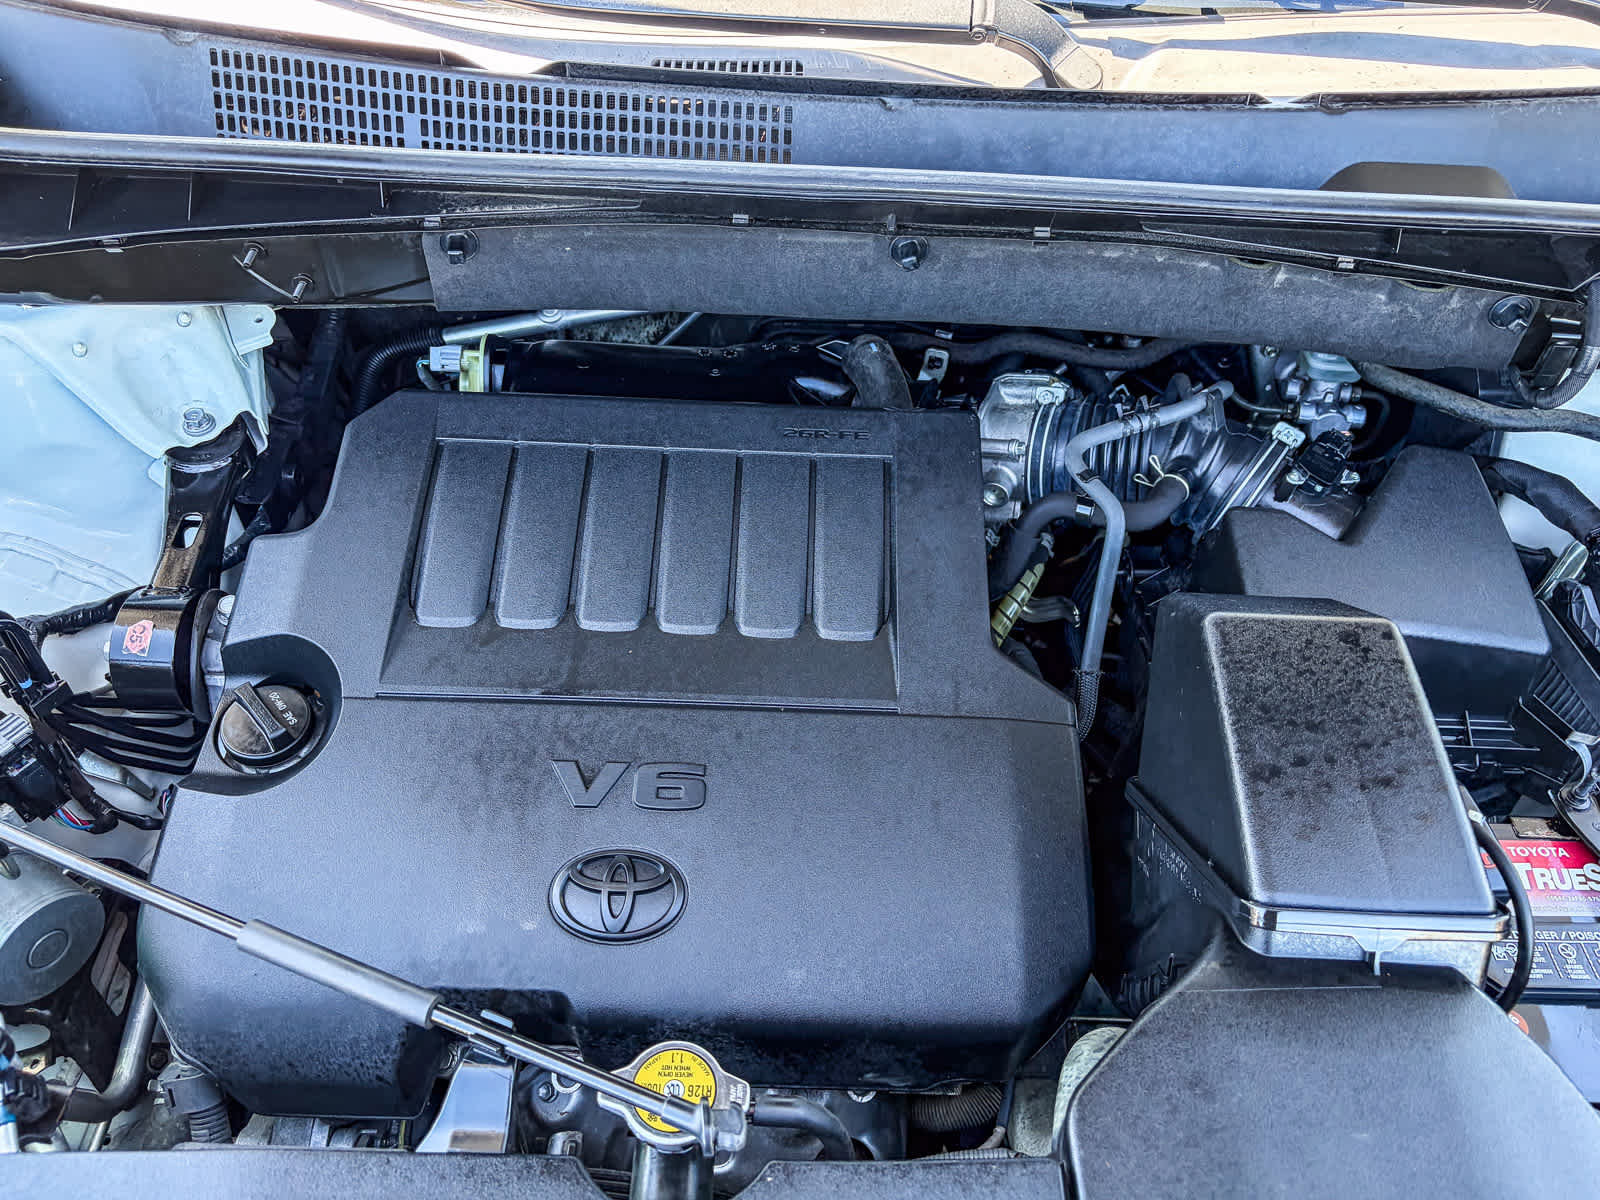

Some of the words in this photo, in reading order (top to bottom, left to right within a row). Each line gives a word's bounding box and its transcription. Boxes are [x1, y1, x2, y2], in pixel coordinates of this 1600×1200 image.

[268, 691, 288, 711] 0W-20
[282, 710, 298, 726] SAE
[550, 759, 707, 811] V6
[1507, 846, 1570, 858] TOYOTA
[687, 1084, 713, 1098] R126
